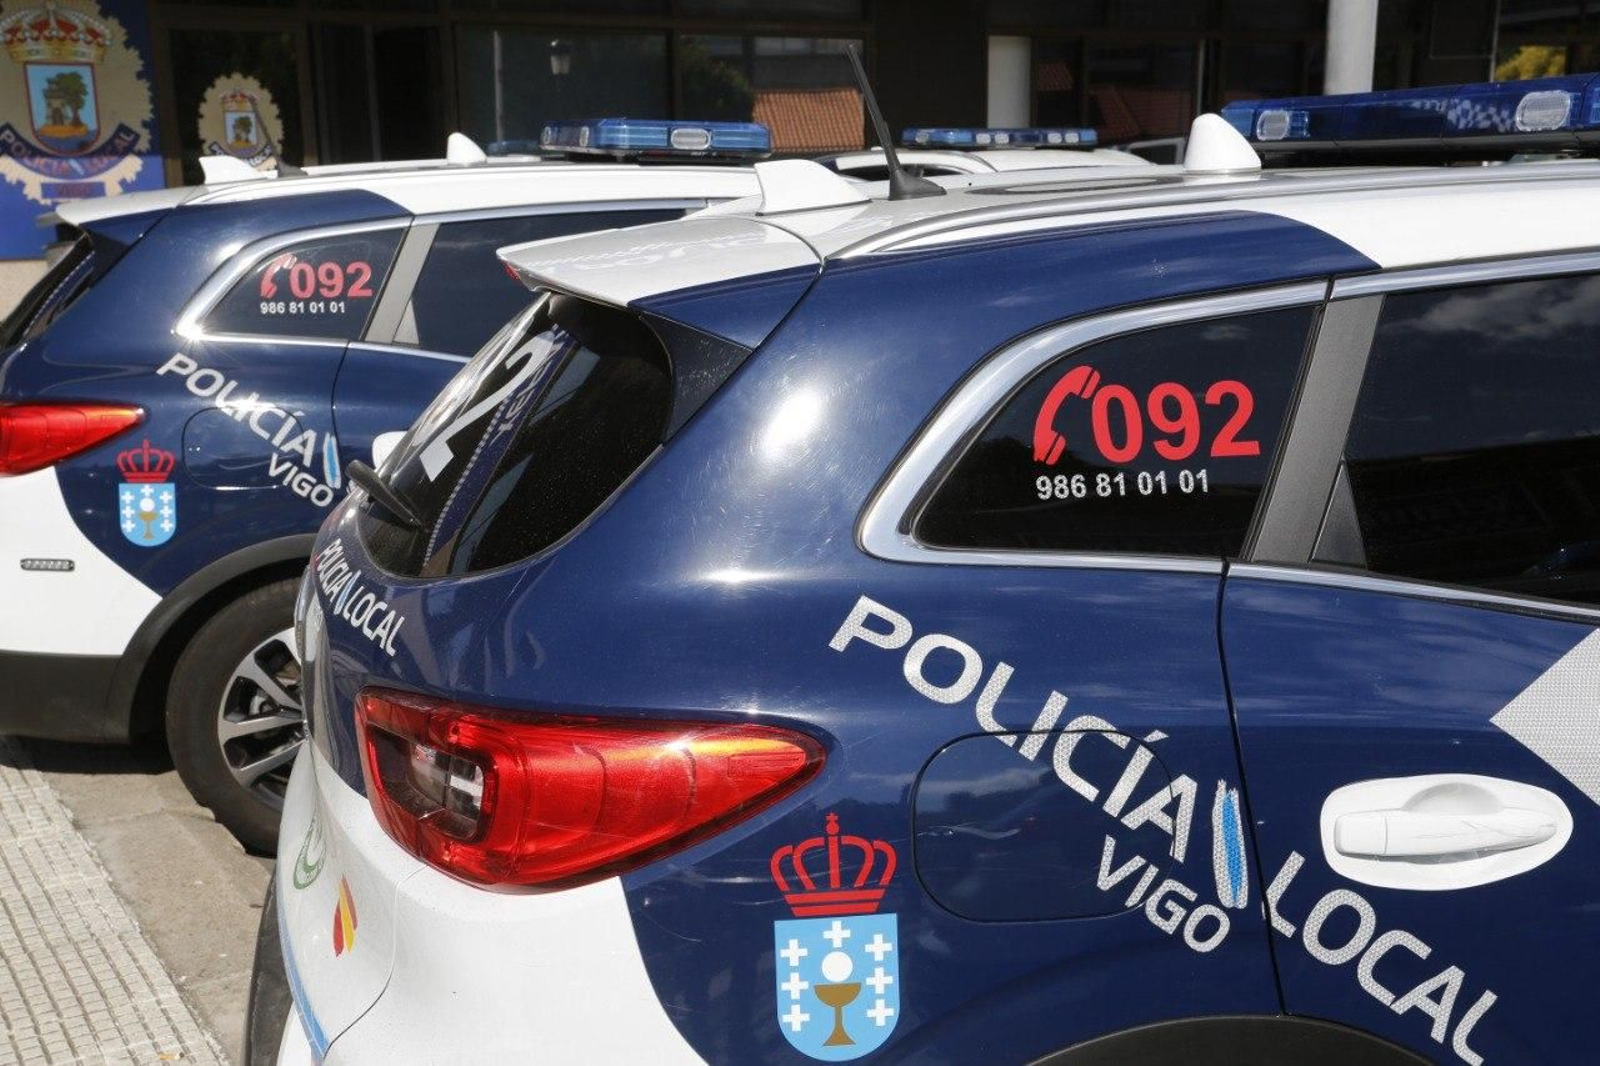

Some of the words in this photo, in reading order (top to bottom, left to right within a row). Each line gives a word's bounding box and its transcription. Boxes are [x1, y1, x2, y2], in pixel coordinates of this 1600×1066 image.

[260, 302, 285, 315] 986
[289, 301, 305, 314] 81
[309, 301, 325, 313] 01
[329, 301, 346, 313] 01
[289, 261, 373, 299] 092
[156, 352, 318, 468] POLICÍA
[1091, 379, 1261, 464] 092
[268, 453, 334, 508] VIGO
[1035, 474, 1087, 500] 986
[1095, 473, 1127, 498] 81
[1136, 470, 1168, 497] 01
[1178, 468, 1209, 494] 01
[342, 585, 405, 655] LOCAL
[828, 594, 1198, 864] POLICÍA
[1260, 850, 1499, 1066] LOCAL
[1096, 834, 1231, 954] VIGO
